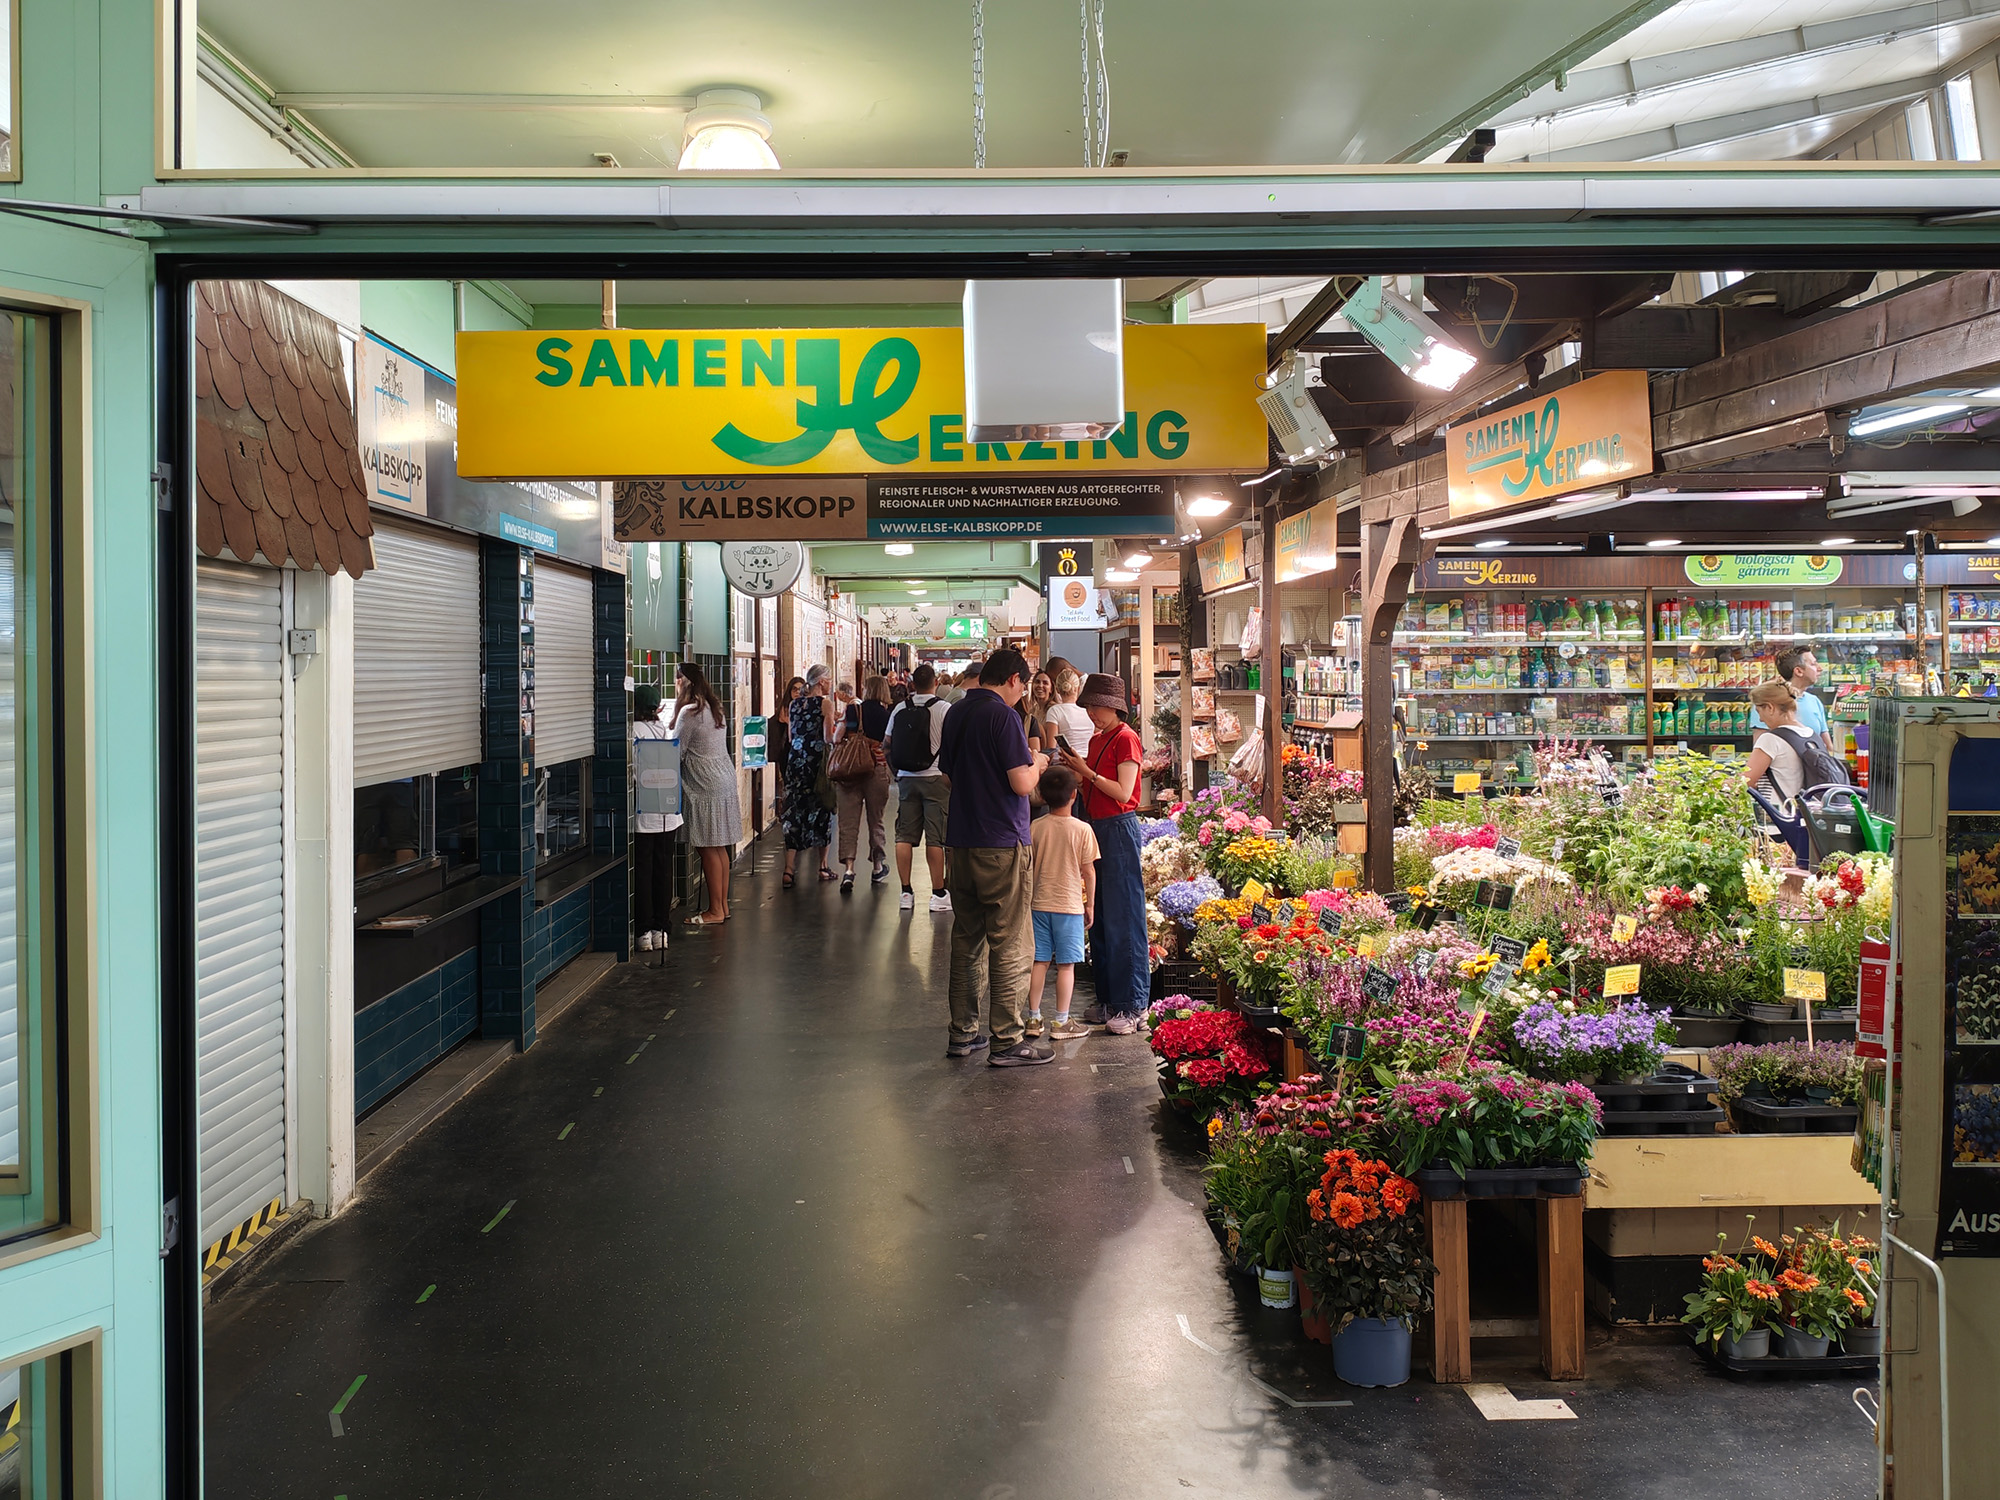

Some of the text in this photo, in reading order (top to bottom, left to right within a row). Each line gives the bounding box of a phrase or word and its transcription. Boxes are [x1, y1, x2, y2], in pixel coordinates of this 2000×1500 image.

[534, 337, 785, 387] SAMEN
[1465, 397, 1625, 496] SAMEN HERZING
[363, 446, 423, 487] KALBSKOPP
[879, 484, 1164, 497] FEINSTE FLEISCH- & WURSTWAREN AUS ARTGERECHTER,
[879, 496, 1121, 509] REGIONALER UND NACHHALTIGER ERZEUGUNG.
[679, 496, 856, 520] KALBSKOPP
[879, 521, 1043, 534] WWW.ELSE-KALBSKOPP.DE
[1437, 559, 1537, 585] SAMEN HERZING
[1734, 555, 1795, 566] biologisch
[1737, 566, 1790, 579] gärtnern
[1948, 1208, 2000, 1233] Aus
